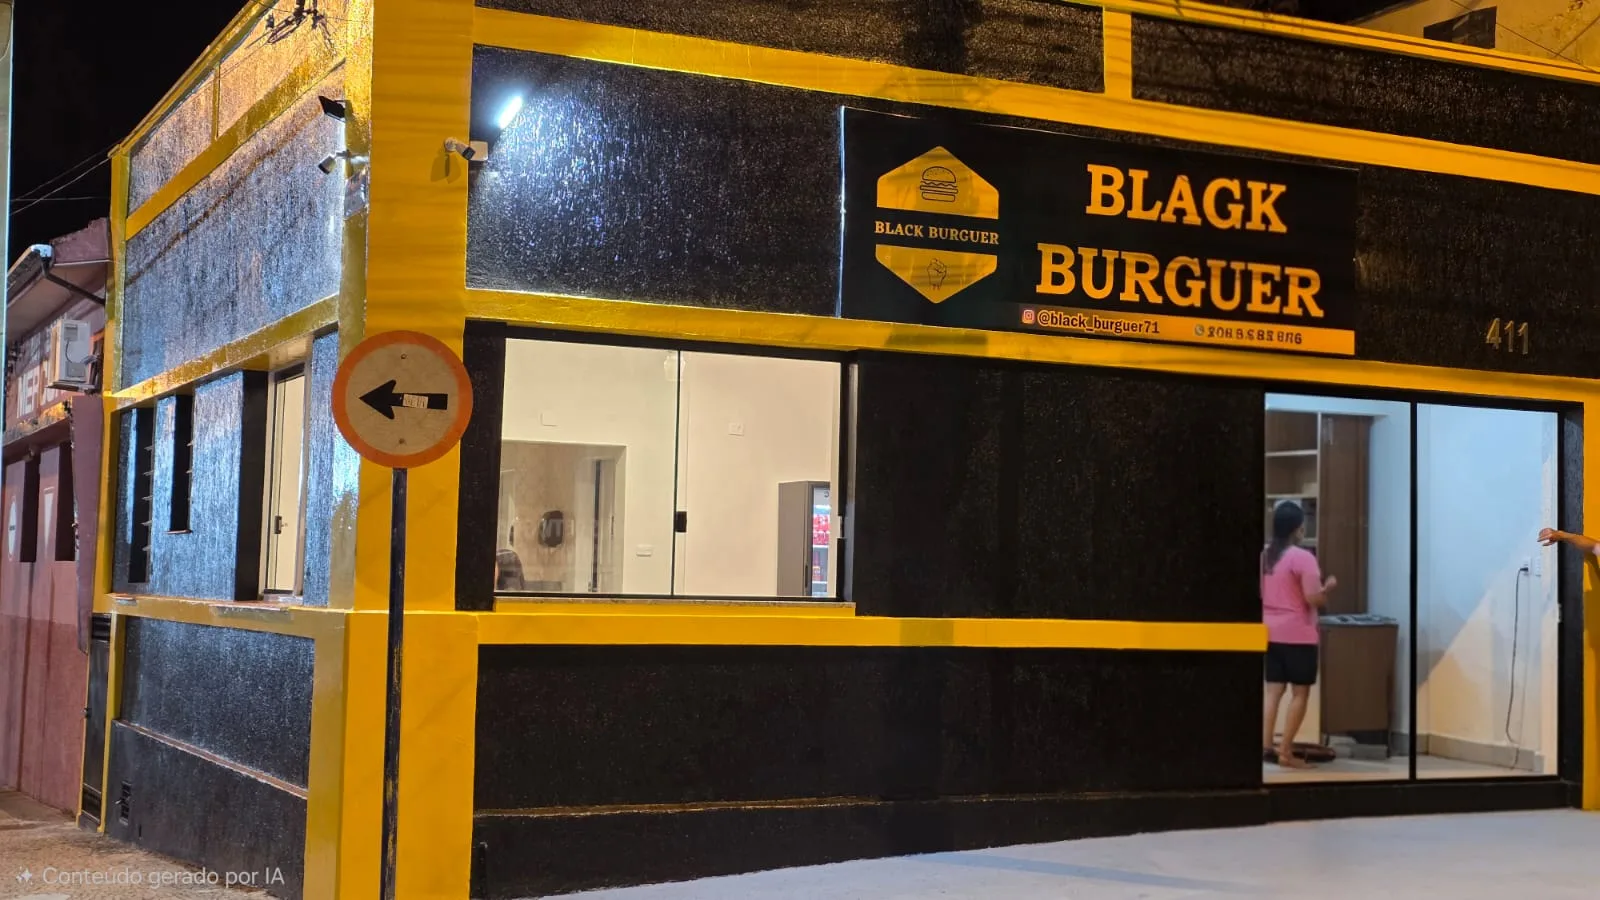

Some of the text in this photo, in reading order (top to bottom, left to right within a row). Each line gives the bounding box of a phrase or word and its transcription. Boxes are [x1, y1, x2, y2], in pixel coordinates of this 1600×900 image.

[1086, 164, 1287, 233] BLAGK
[875, 221, 999, 245] BLACK BURGUER
[1036, 243, 1324, 317] BURGUER
[1038, 310, 1160, 334] @black_burguer71
[1486, 317, 1528, 355] 411
